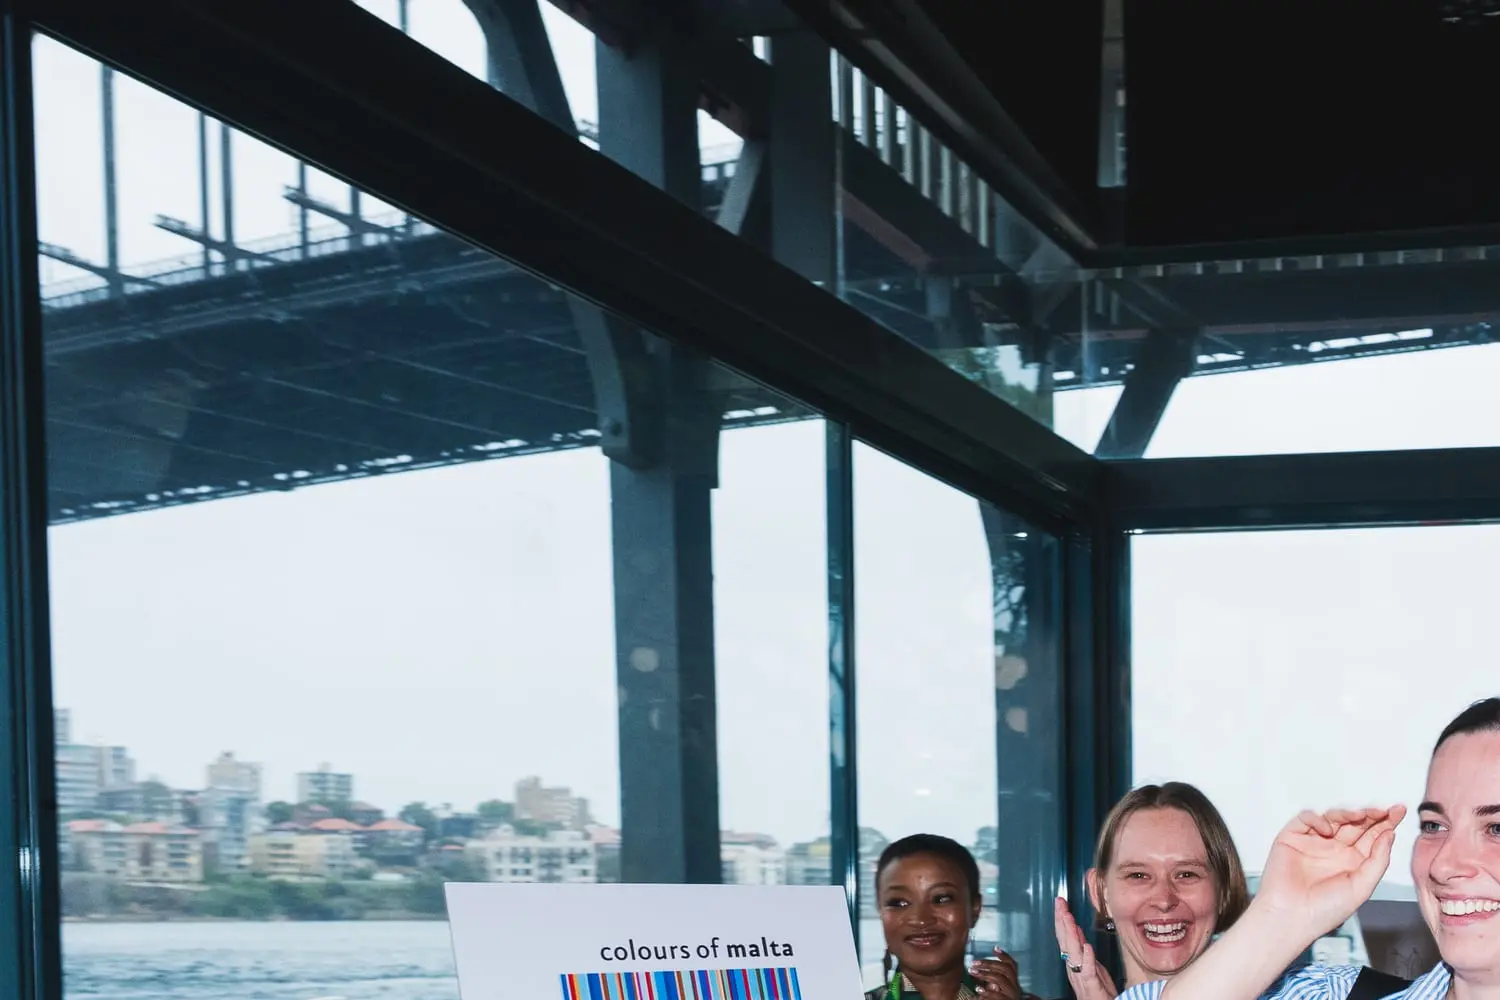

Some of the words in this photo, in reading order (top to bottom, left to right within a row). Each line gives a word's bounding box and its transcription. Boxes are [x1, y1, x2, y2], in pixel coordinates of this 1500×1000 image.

[600, 938, 691, 961] colours
[696, 937, 720, 959] of
[726, 936, 794, 958] malta
